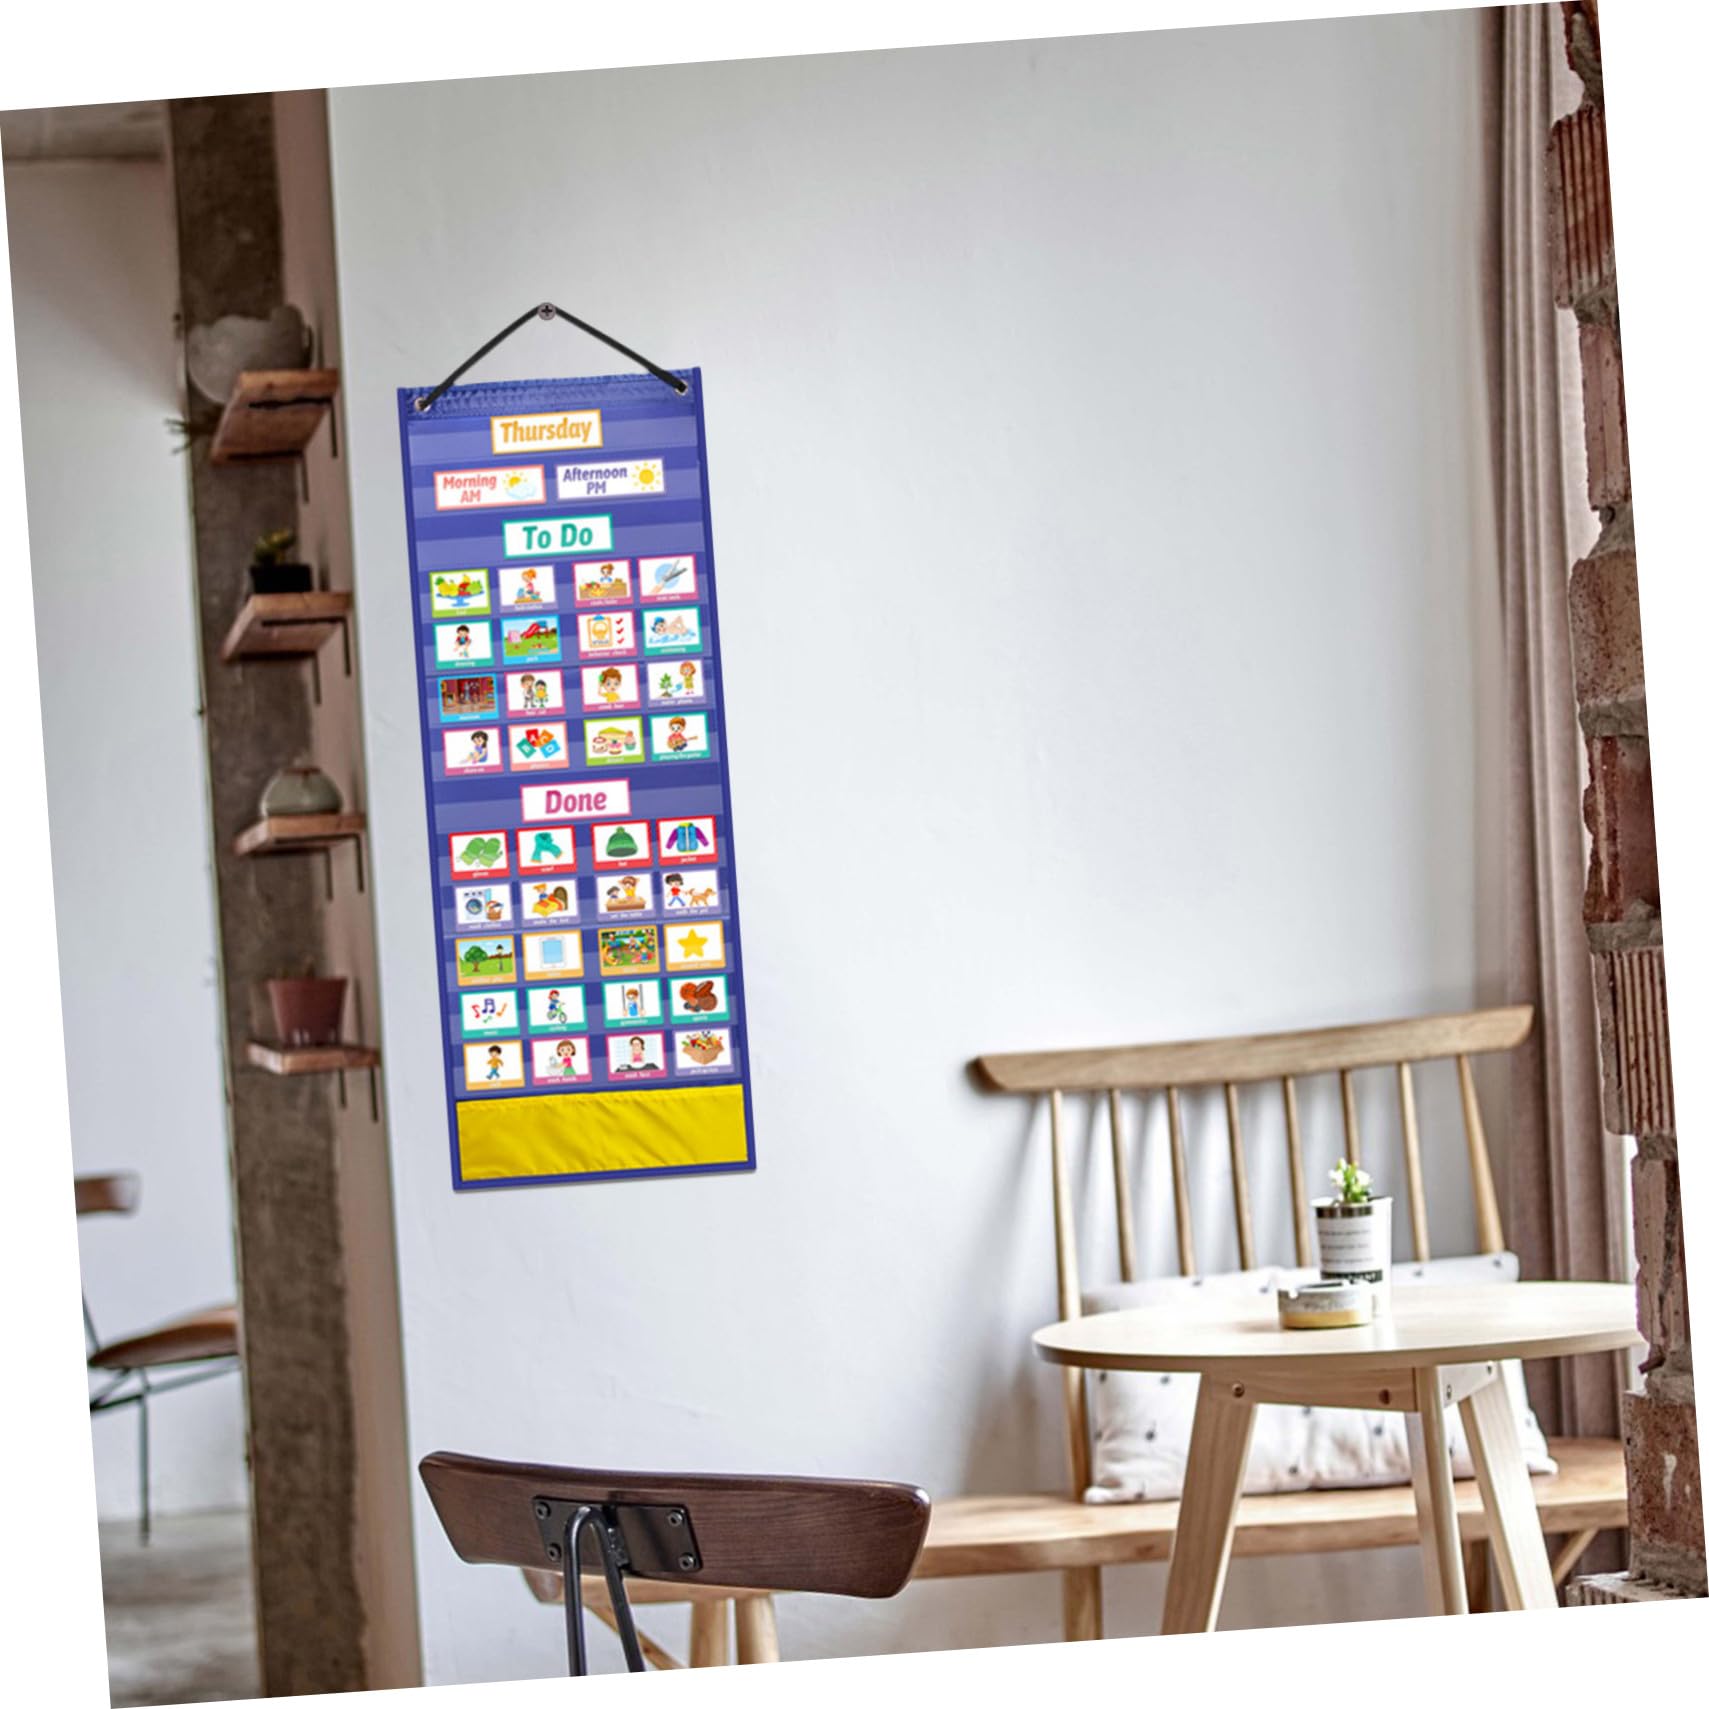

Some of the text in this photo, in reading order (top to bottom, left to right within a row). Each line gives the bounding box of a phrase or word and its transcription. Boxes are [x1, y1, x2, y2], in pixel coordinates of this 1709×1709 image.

[500, 417, 592, 443] Thursday
[443, 474, 497, 490] Morning
[563, 466, 628, 482] Afternoon
[587, 481, 606, 494] PM
[460, 490, 481, 503] AM
[522, 523, 592, 550] To Do
[546, 790, 607, 814] Done
